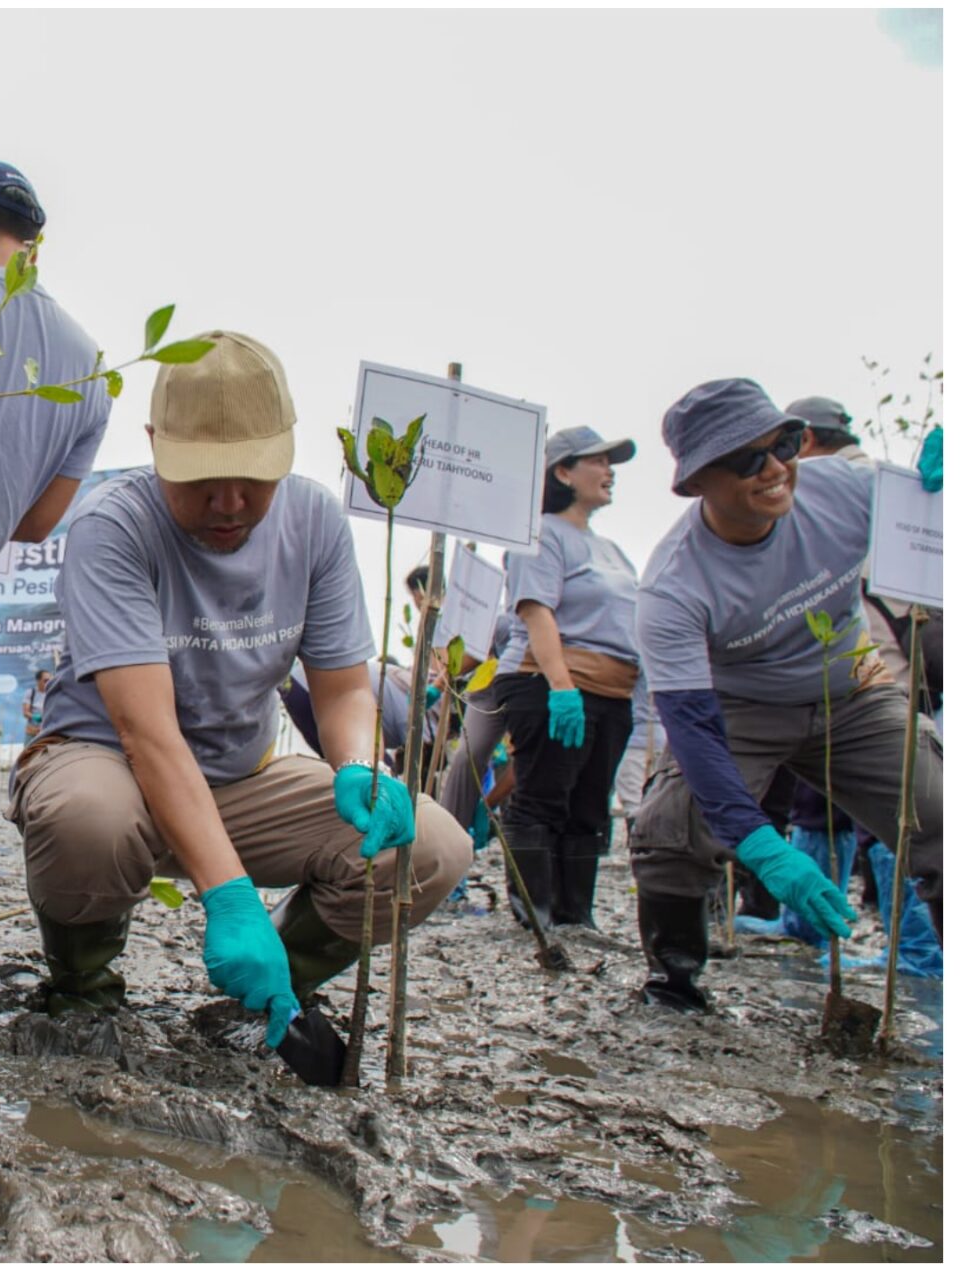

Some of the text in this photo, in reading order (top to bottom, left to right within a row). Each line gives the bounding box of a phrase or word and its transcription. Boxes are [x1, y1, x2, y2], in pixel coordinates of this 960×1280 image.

[423, 439, 480, 459] HEAD OF HR
[413, 456, 434, 468] ERU
[13, 578, 54, 596] Pesi
